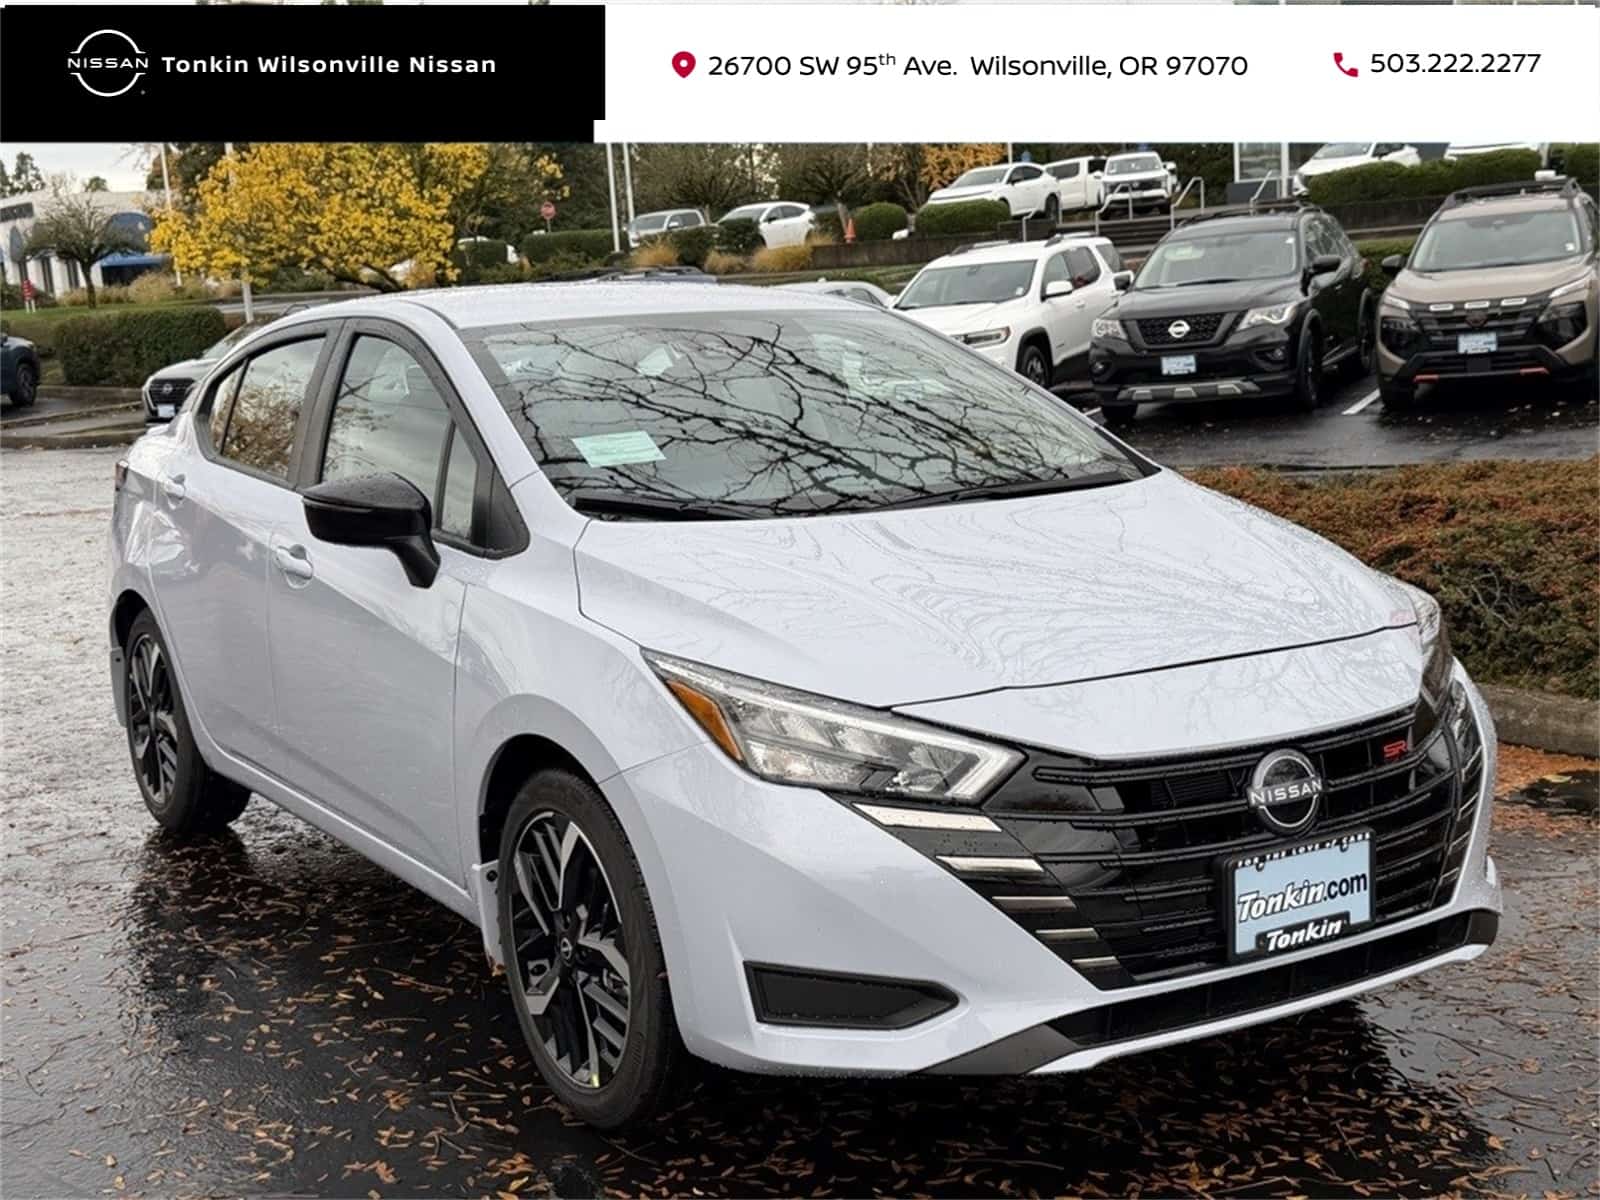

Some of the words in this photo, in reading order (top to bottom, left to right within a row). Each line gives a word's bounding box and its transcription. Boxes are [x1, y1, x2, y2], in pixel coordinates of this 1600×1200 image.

[1250, 778, 1323, 804] NISSAN
[1238, 871, 1368, 923] Tonkin.com
[1266, 918, 1343, 951] Tonkin
